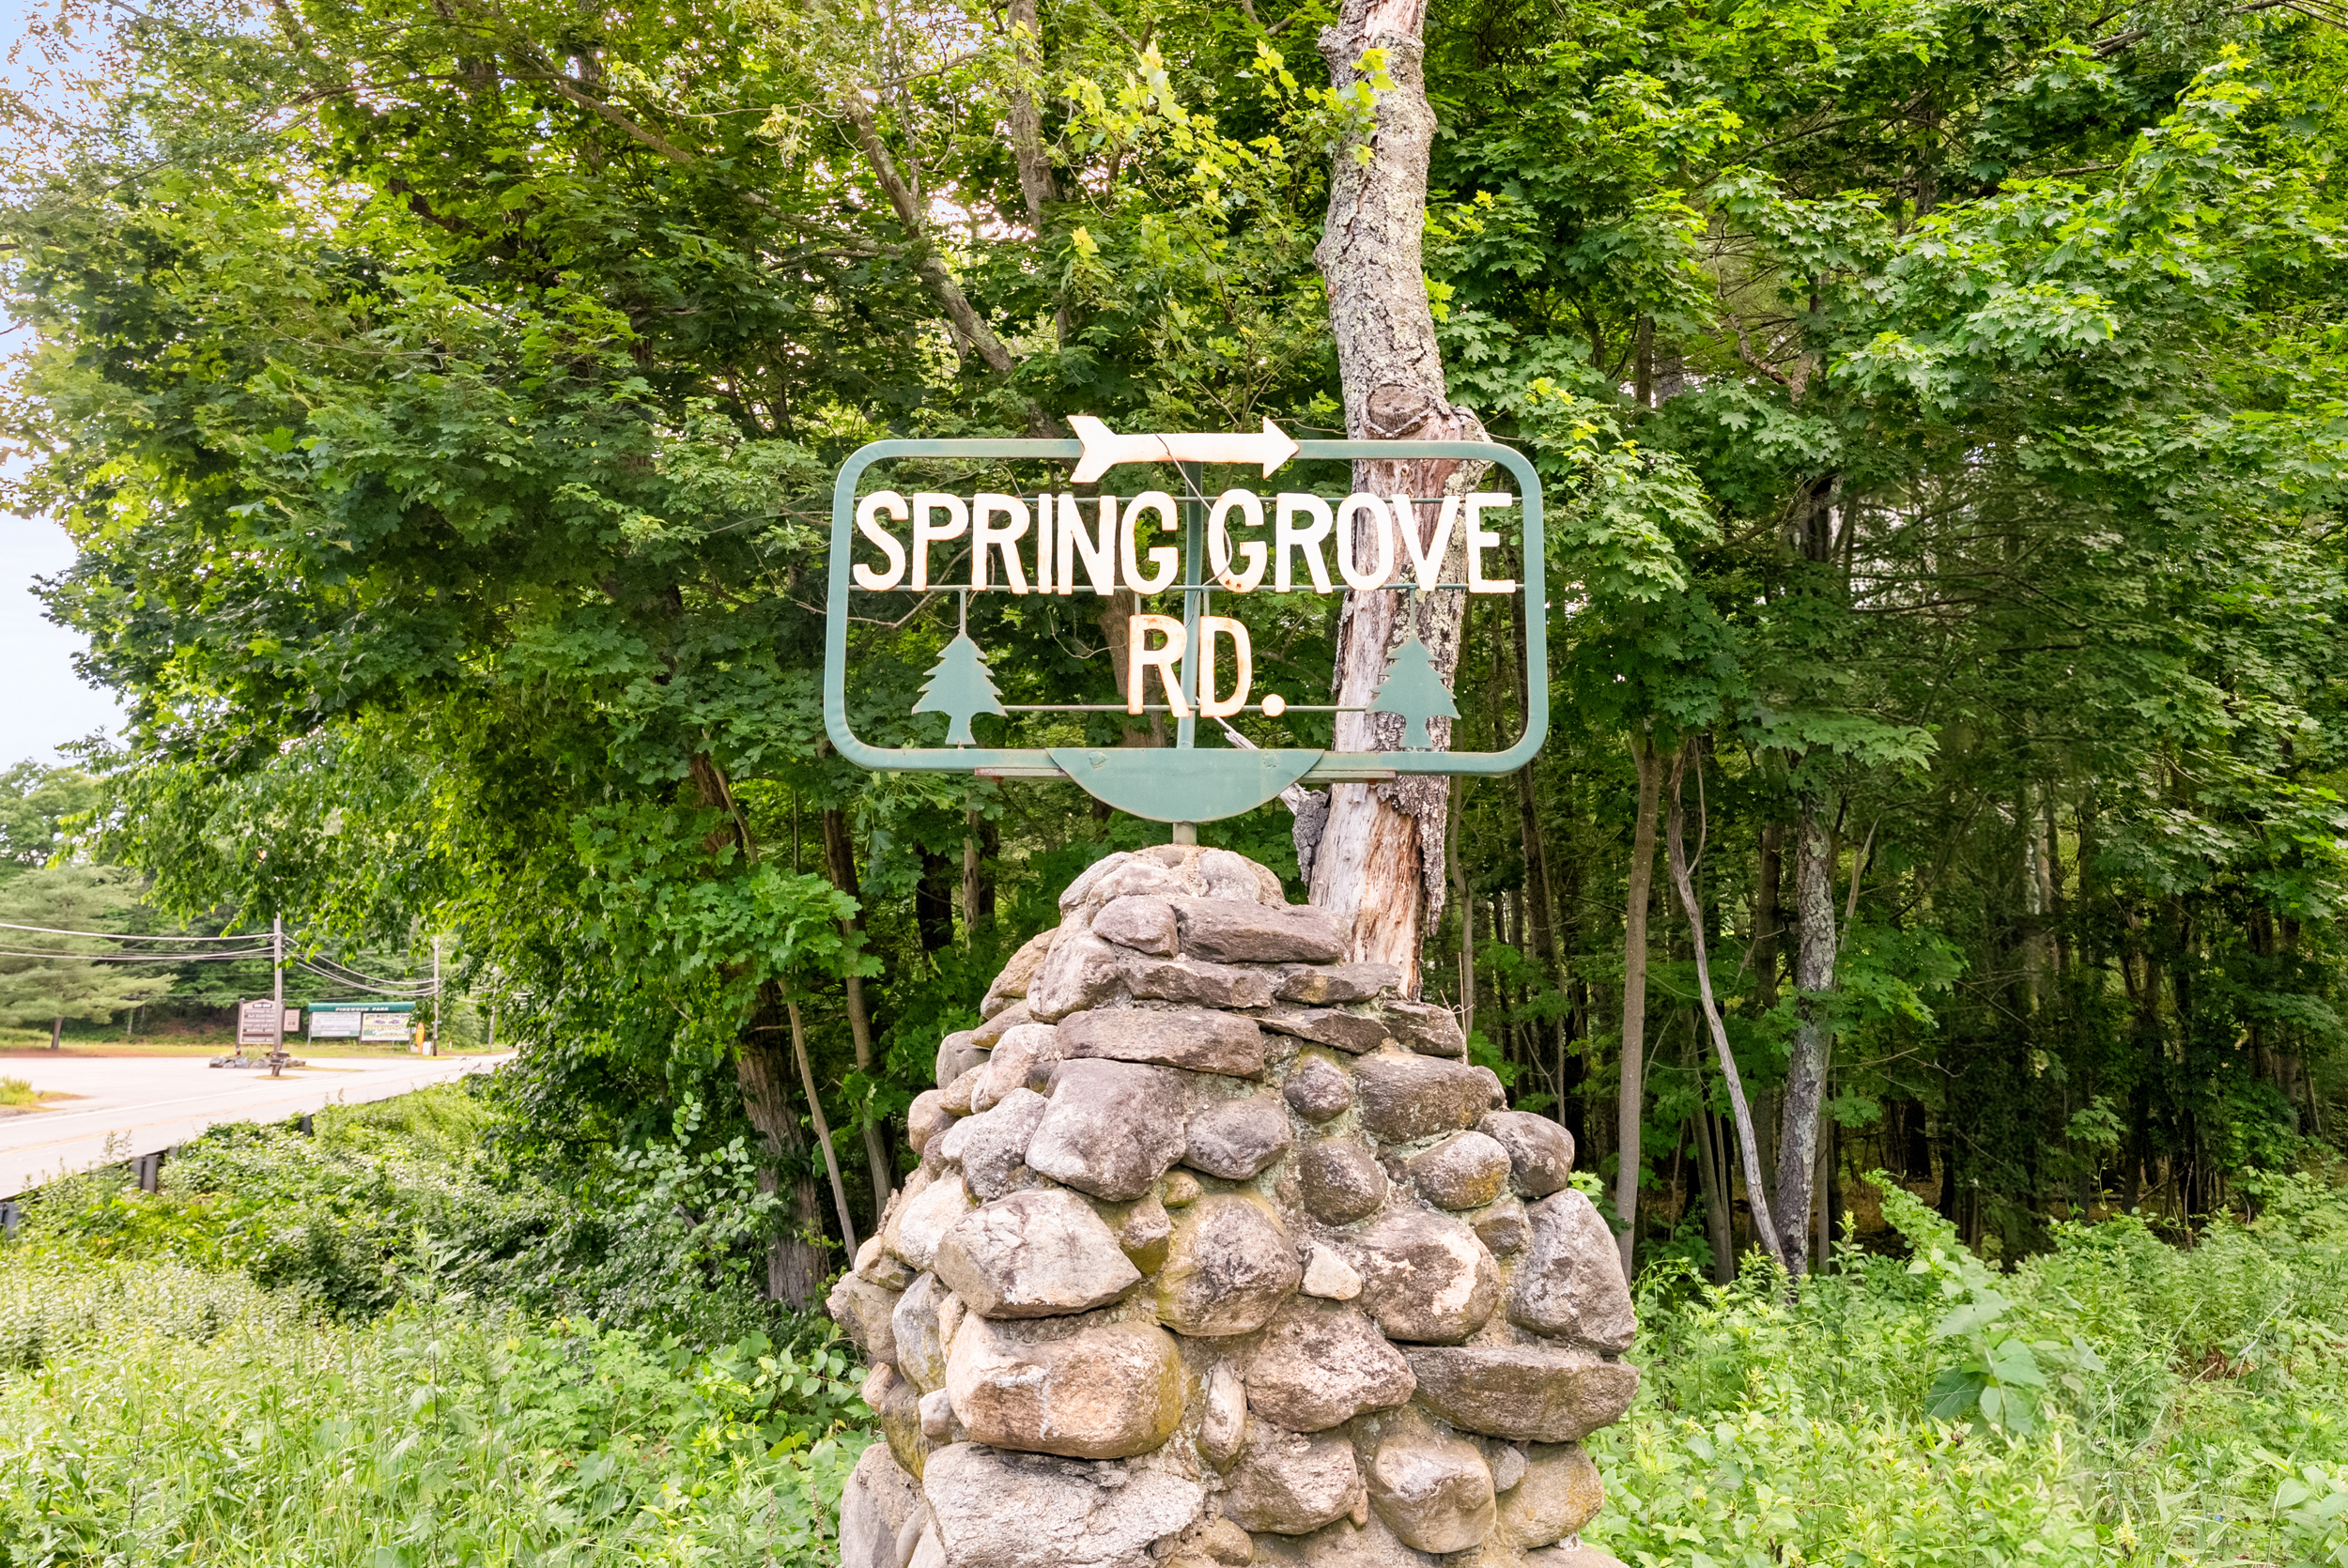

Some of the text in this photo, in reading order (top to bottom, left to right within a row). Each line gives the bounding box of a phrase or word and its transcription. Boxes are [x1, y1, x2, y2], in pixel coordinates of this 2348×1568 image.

[853, 488, 1516, 595] SPRING GROVE
[1127, 614, 1287, 718] RD.
